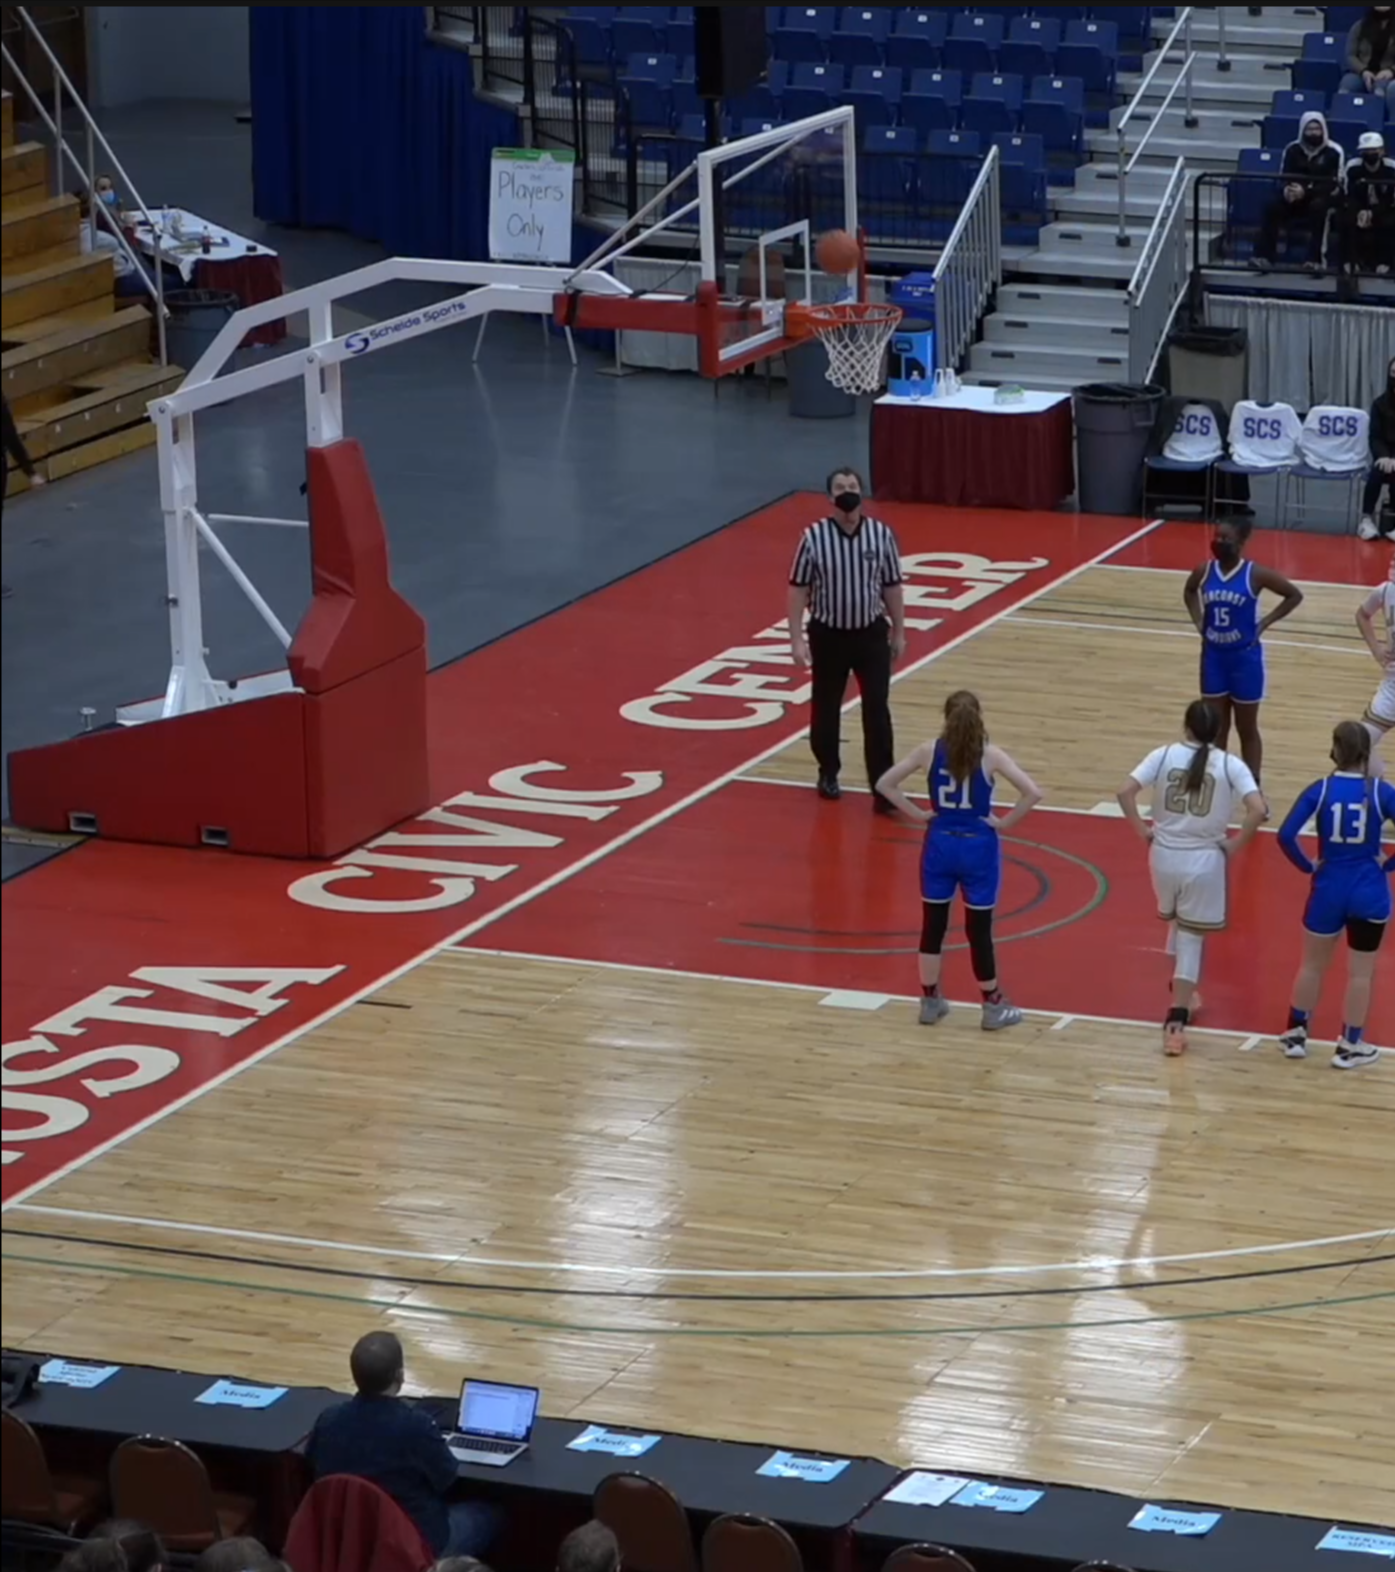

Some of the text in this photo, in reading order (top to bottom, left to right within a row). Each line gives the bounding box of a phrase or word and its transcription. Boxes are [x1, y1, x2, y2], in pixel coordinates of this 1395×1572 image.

[498, 170, 564, 209] Players
[507, 212, 545, 252] Only
[422, 302, 466, 322] Sports
[1243, 417, 1282, 440] SCS
[1318, 415, 1359, 437] SCS
[1213, 607, 1230, 627] 15
[287, 760, 664, 913] CIVIC
[619, 551, 1050, 730] CENER
[938, 767, 973, 809] 21
[1165, 767, 1217, 818] 20
[1329, 801, 1368, 844] 13
